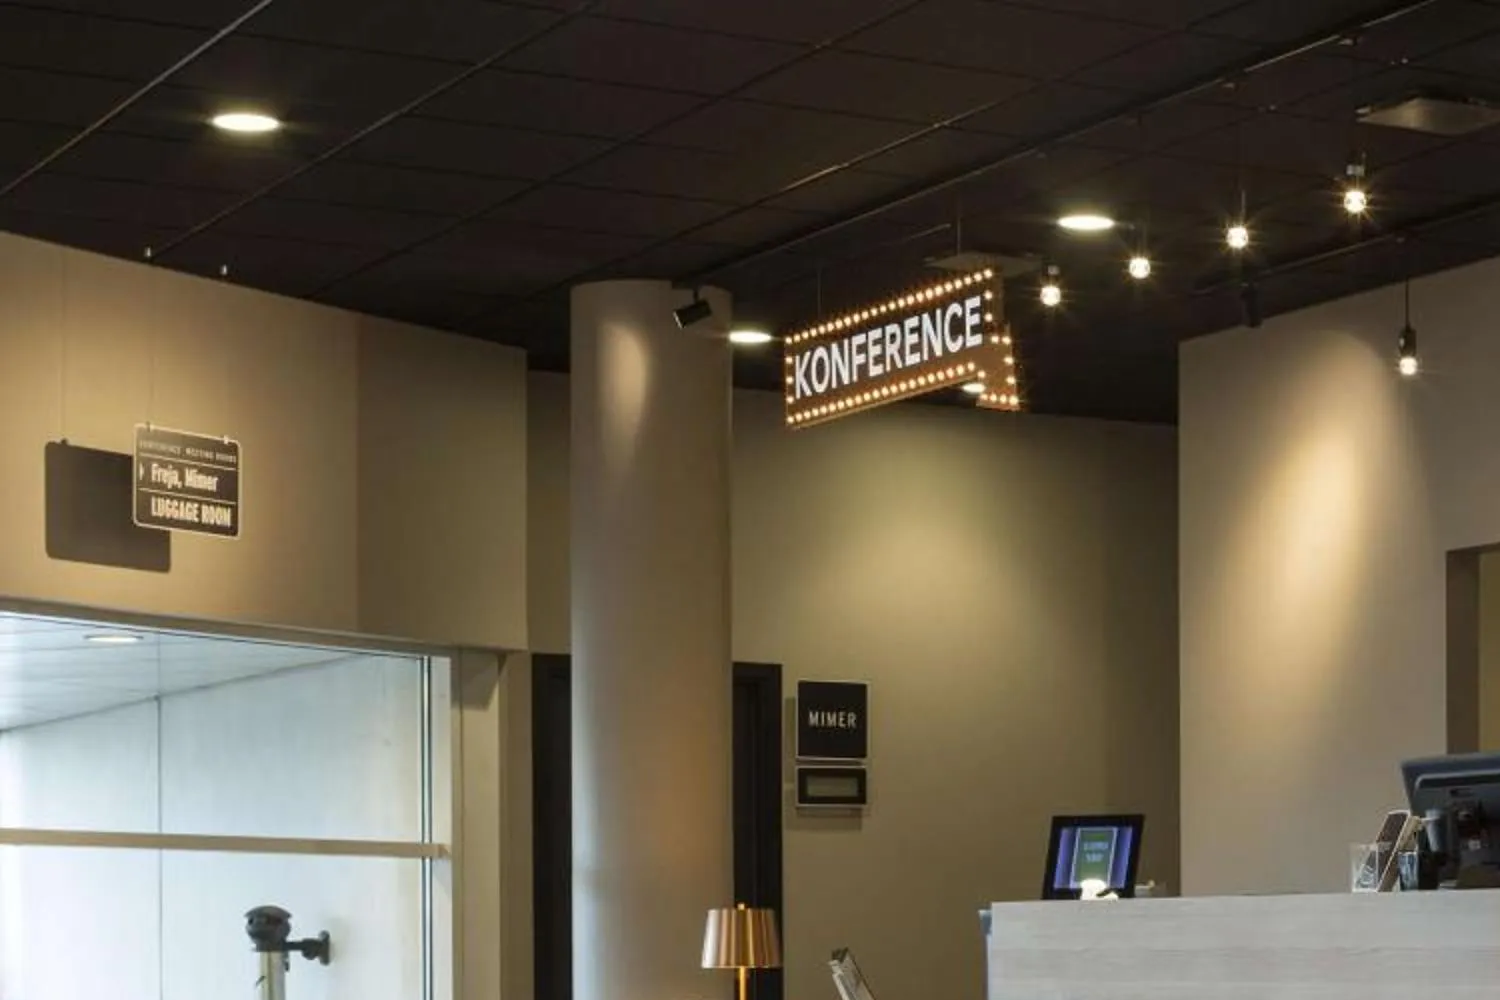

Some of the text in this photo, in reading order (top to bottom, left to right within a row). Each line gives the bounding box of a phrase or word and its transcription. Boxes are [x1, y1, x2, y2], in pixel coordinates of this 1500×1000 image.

[794, 296, 983, 399] KONFERENCE
[151, 496, 231, 528] LUGGAGE ROOM
[809, 711, 857, 729] MIMER
